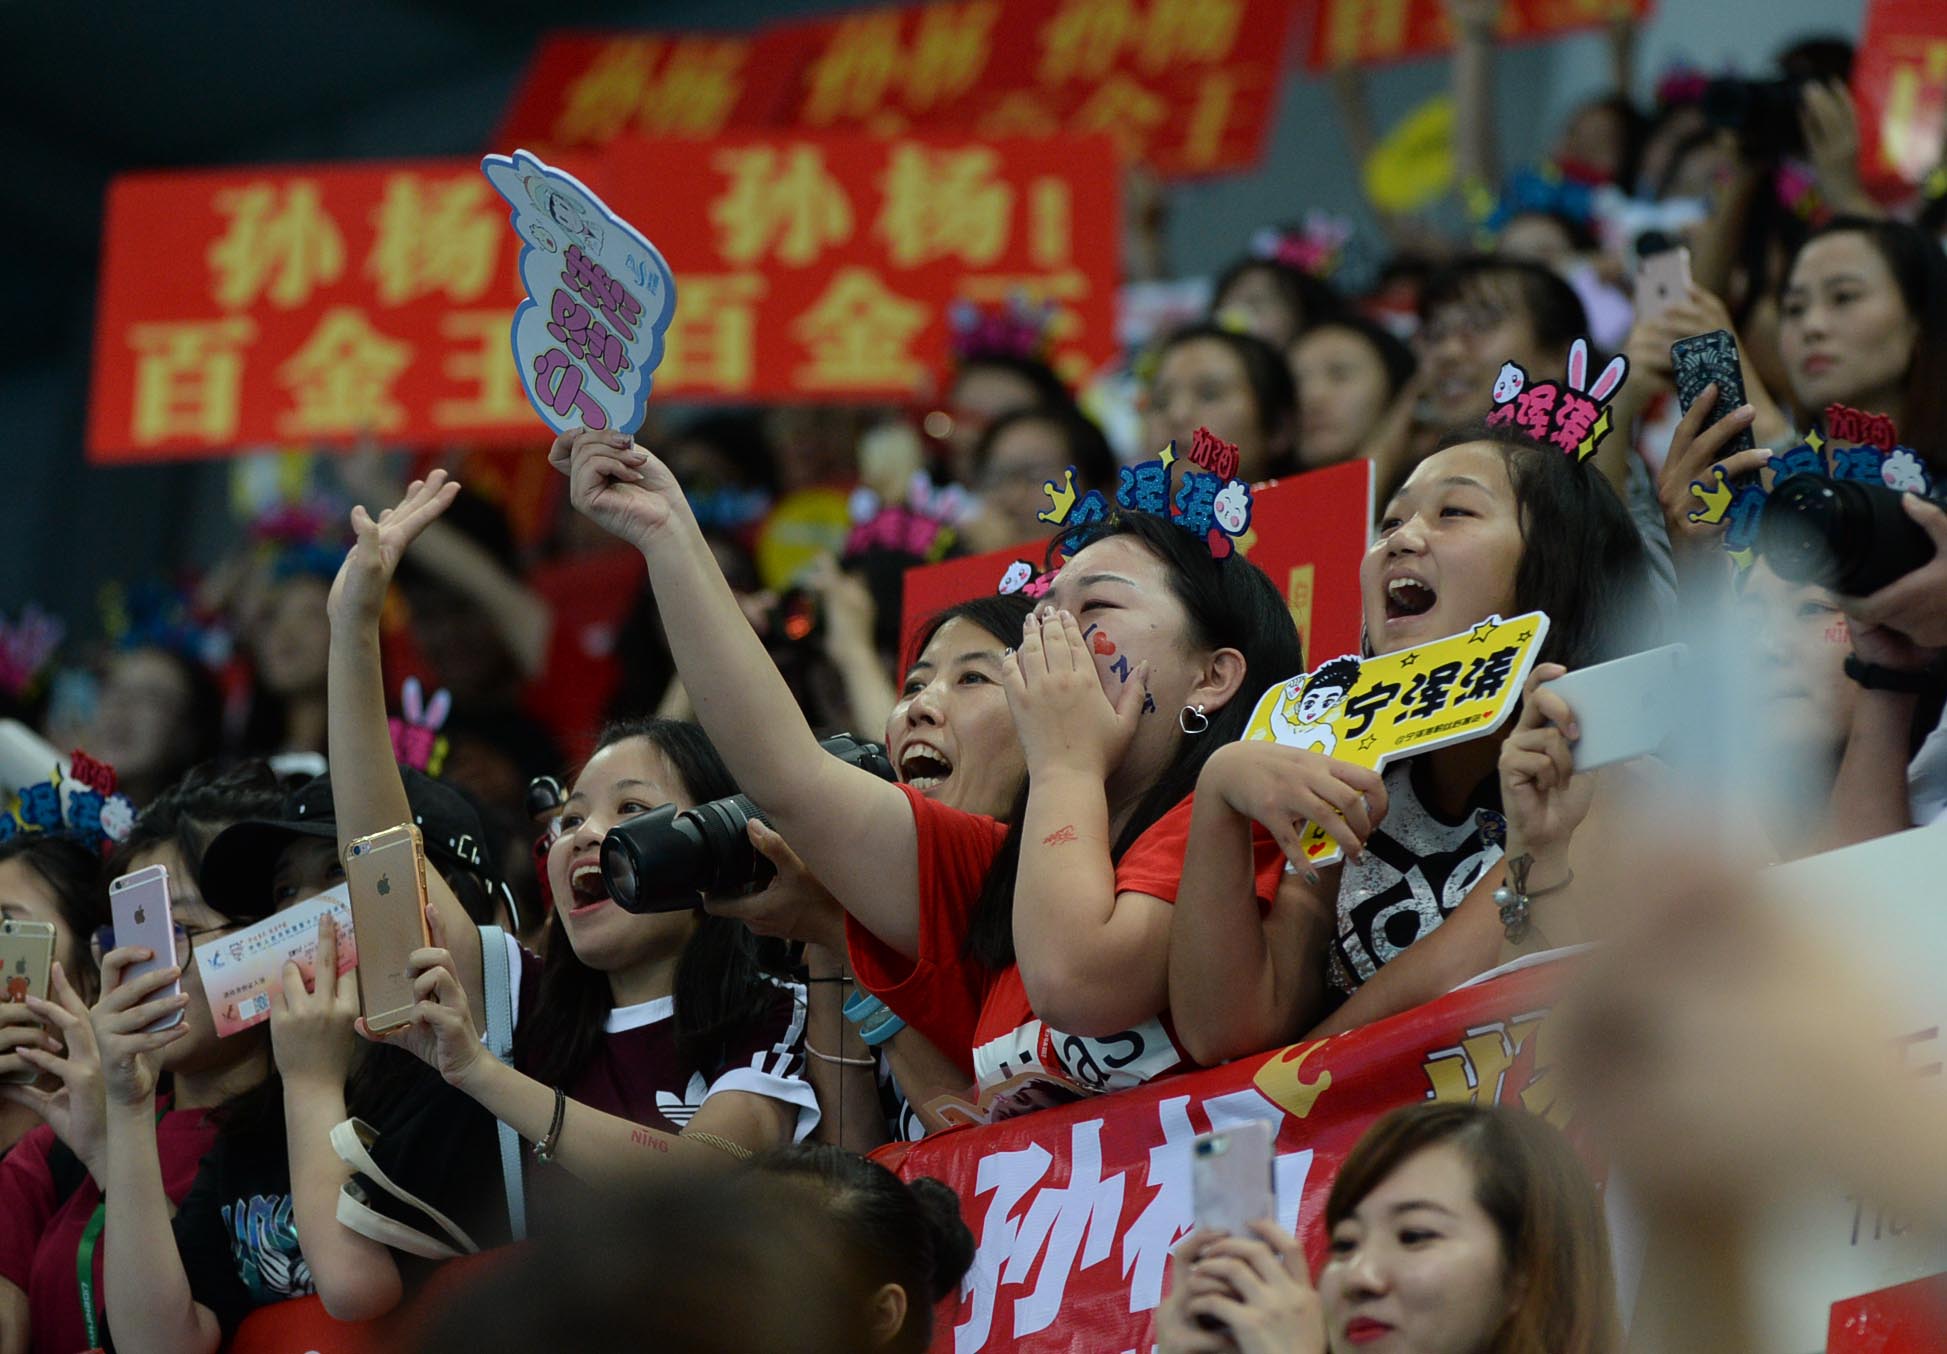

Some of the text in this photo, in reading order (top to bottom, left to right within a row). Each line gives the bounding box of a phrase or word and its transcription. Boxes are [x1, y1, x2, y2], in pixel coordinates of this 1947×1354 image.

[534, 245, 641, 430] 宁泽涛
[1345, 646, 1520, 739] 宁泽涛
